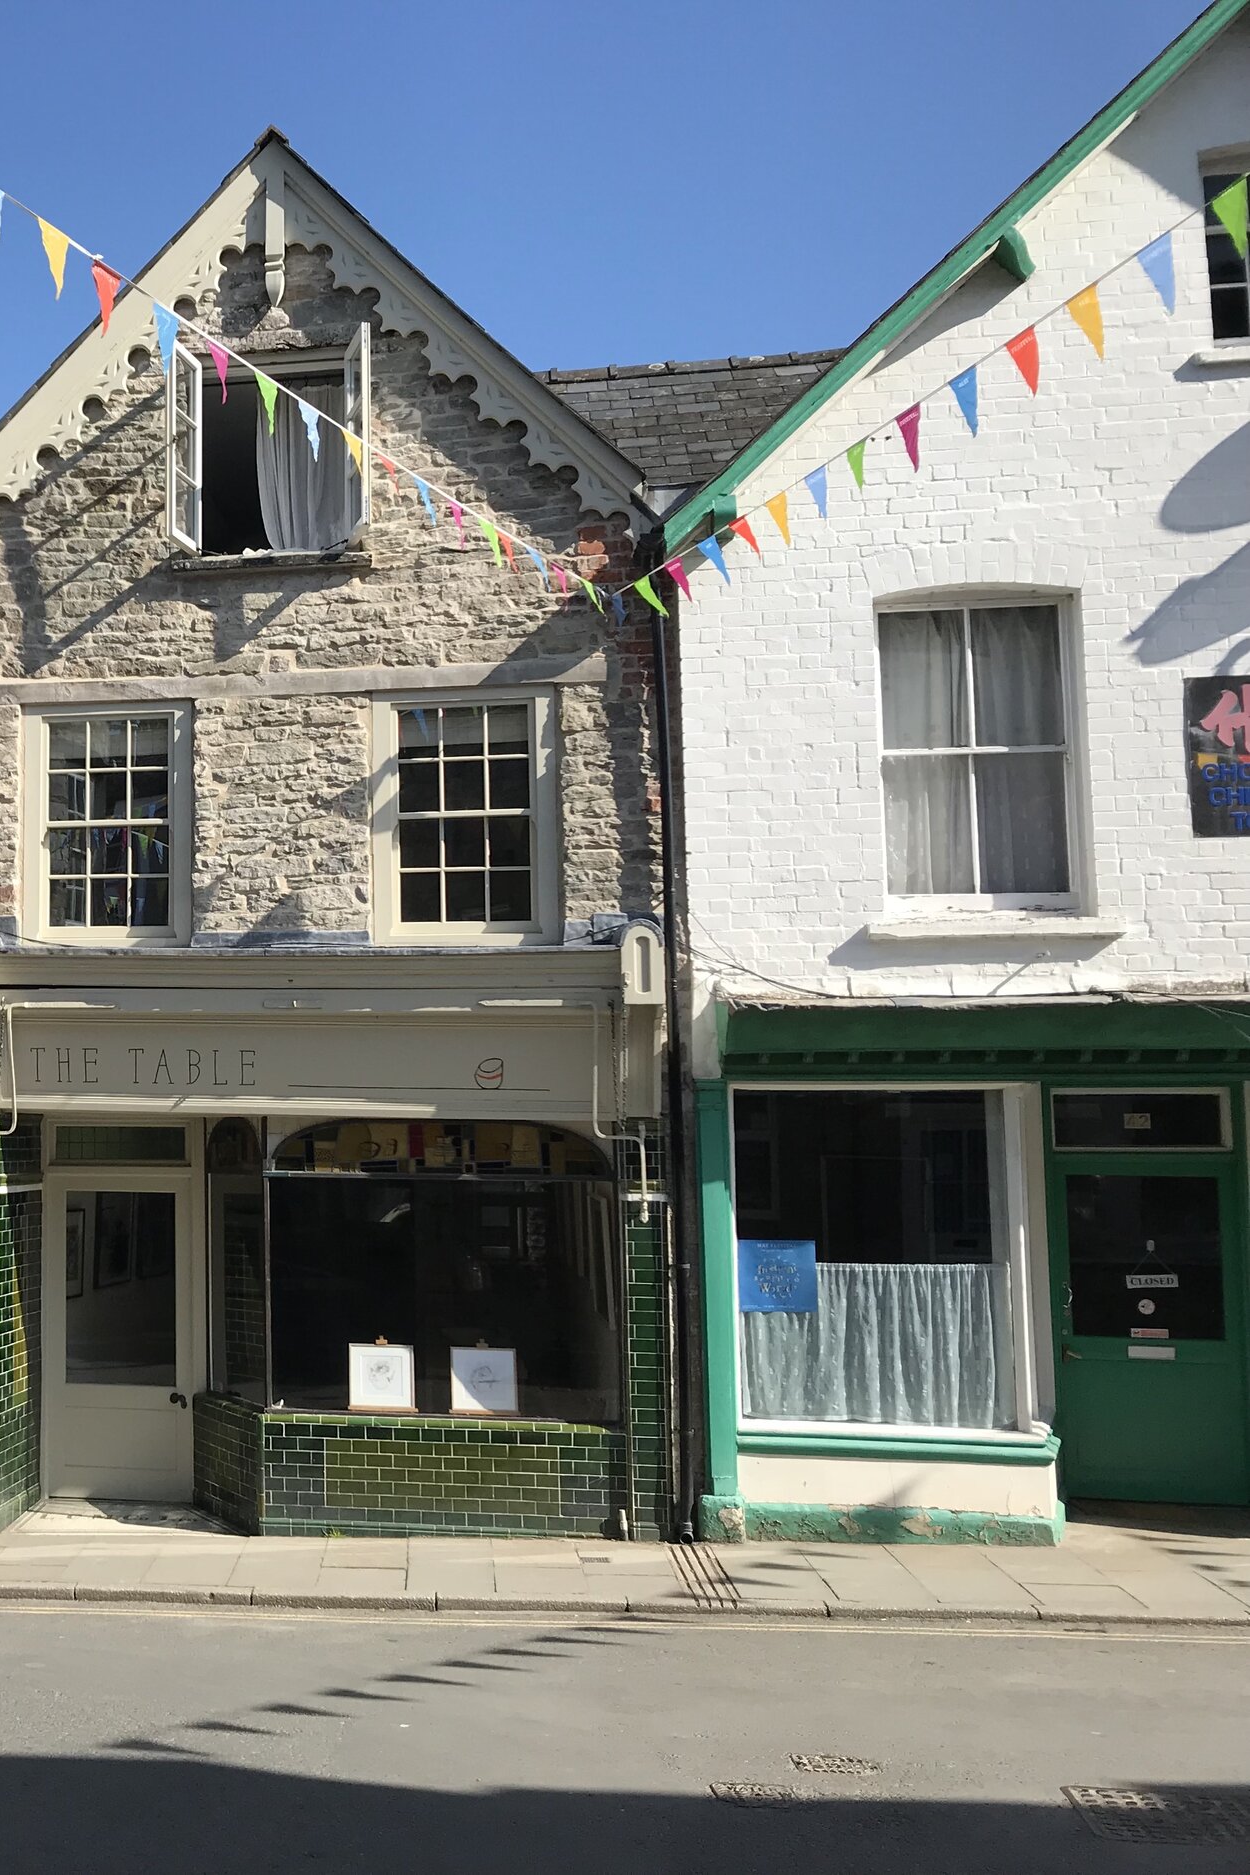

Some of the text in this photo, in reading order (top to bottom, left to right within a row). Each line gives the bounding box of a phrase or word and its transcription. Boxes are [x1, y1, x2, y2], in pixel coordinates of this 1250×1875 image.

[30, 1048, 255, 1086] THE TABLE
[1131, 1277, 1174, 1286] CLOSED
